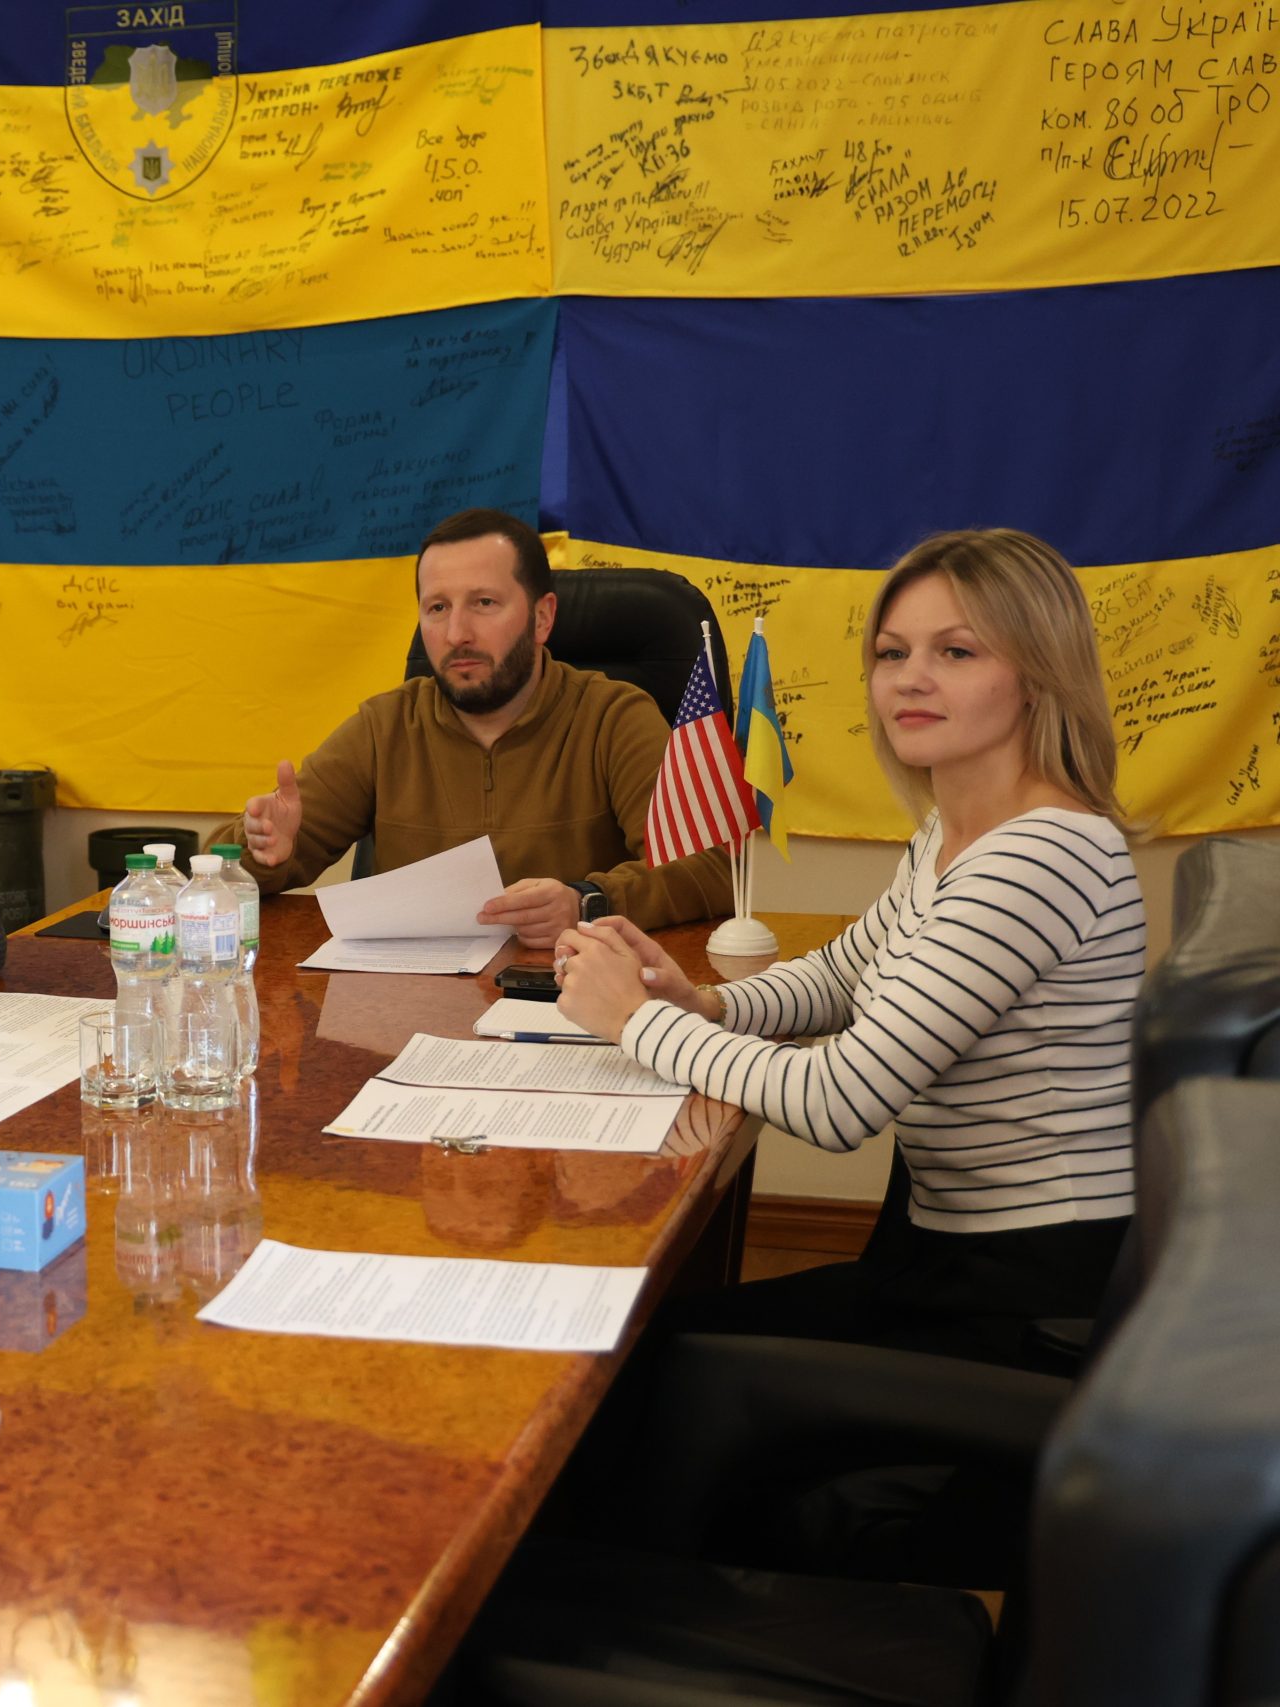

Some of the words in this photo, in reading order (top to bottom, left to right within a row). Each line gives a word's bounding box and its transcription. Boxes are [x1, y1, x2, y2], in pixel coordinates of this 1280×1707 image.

[117, 5, 184, 27] ЗАХІД
[1045, 18, 1138, 45] СЛАВА
[1050, 56, 1172, 91] ГЕРОЯМ
[1105, 97, 1138, 130] 86
[874, 178, 931, 224] РАЗОМ
[1059, 191, 1224, 228] 15.07.2022
[122, 331, 305, 379] ORDINARY
[62, 574, 120, 595] ДСНС
[1091, 599, 1120, 624] 86
